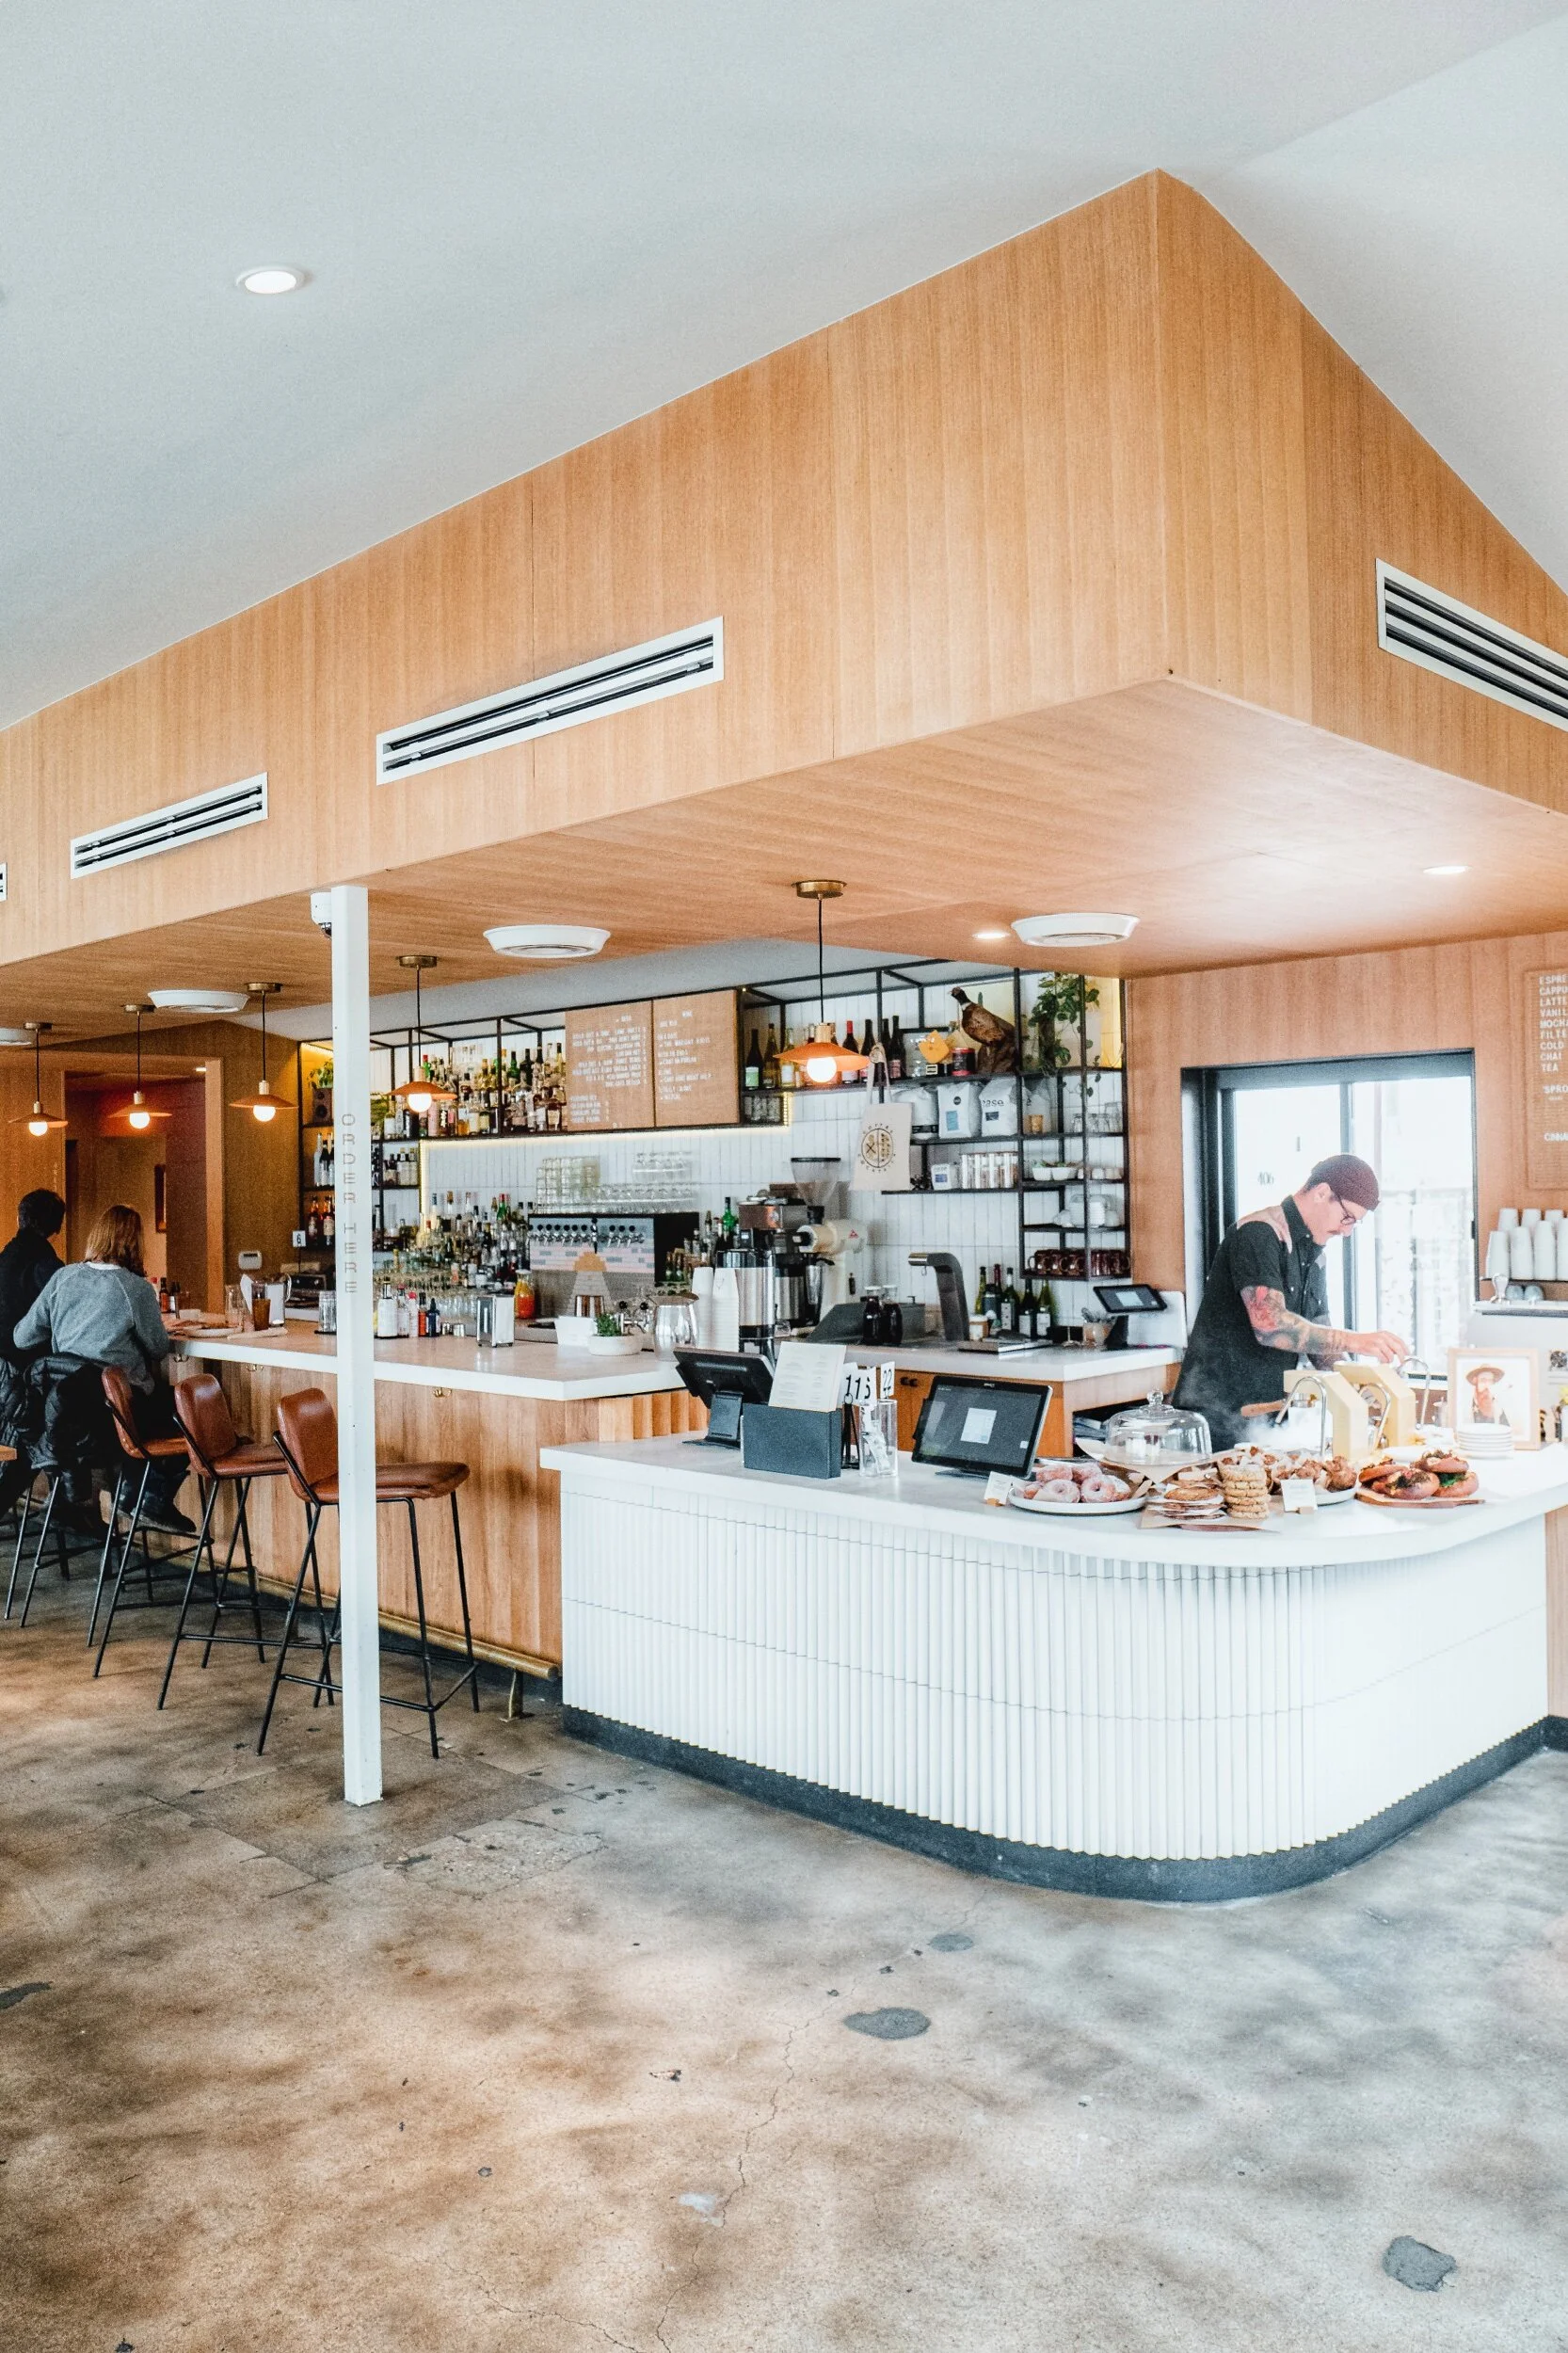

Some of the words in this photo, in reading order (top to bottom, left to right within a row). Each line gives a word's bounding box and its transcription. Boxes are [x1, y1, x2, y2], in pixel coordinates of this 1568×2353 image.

[1540, 1041, 1564, 1050] COLD
[1540, 1052, 1561, 1061] CHAI
[1542, 1063, 1559, 1072] TEA
[342, 1113, 357, 1204] ORDER
[344, 1223, 358, 1293] HERE
